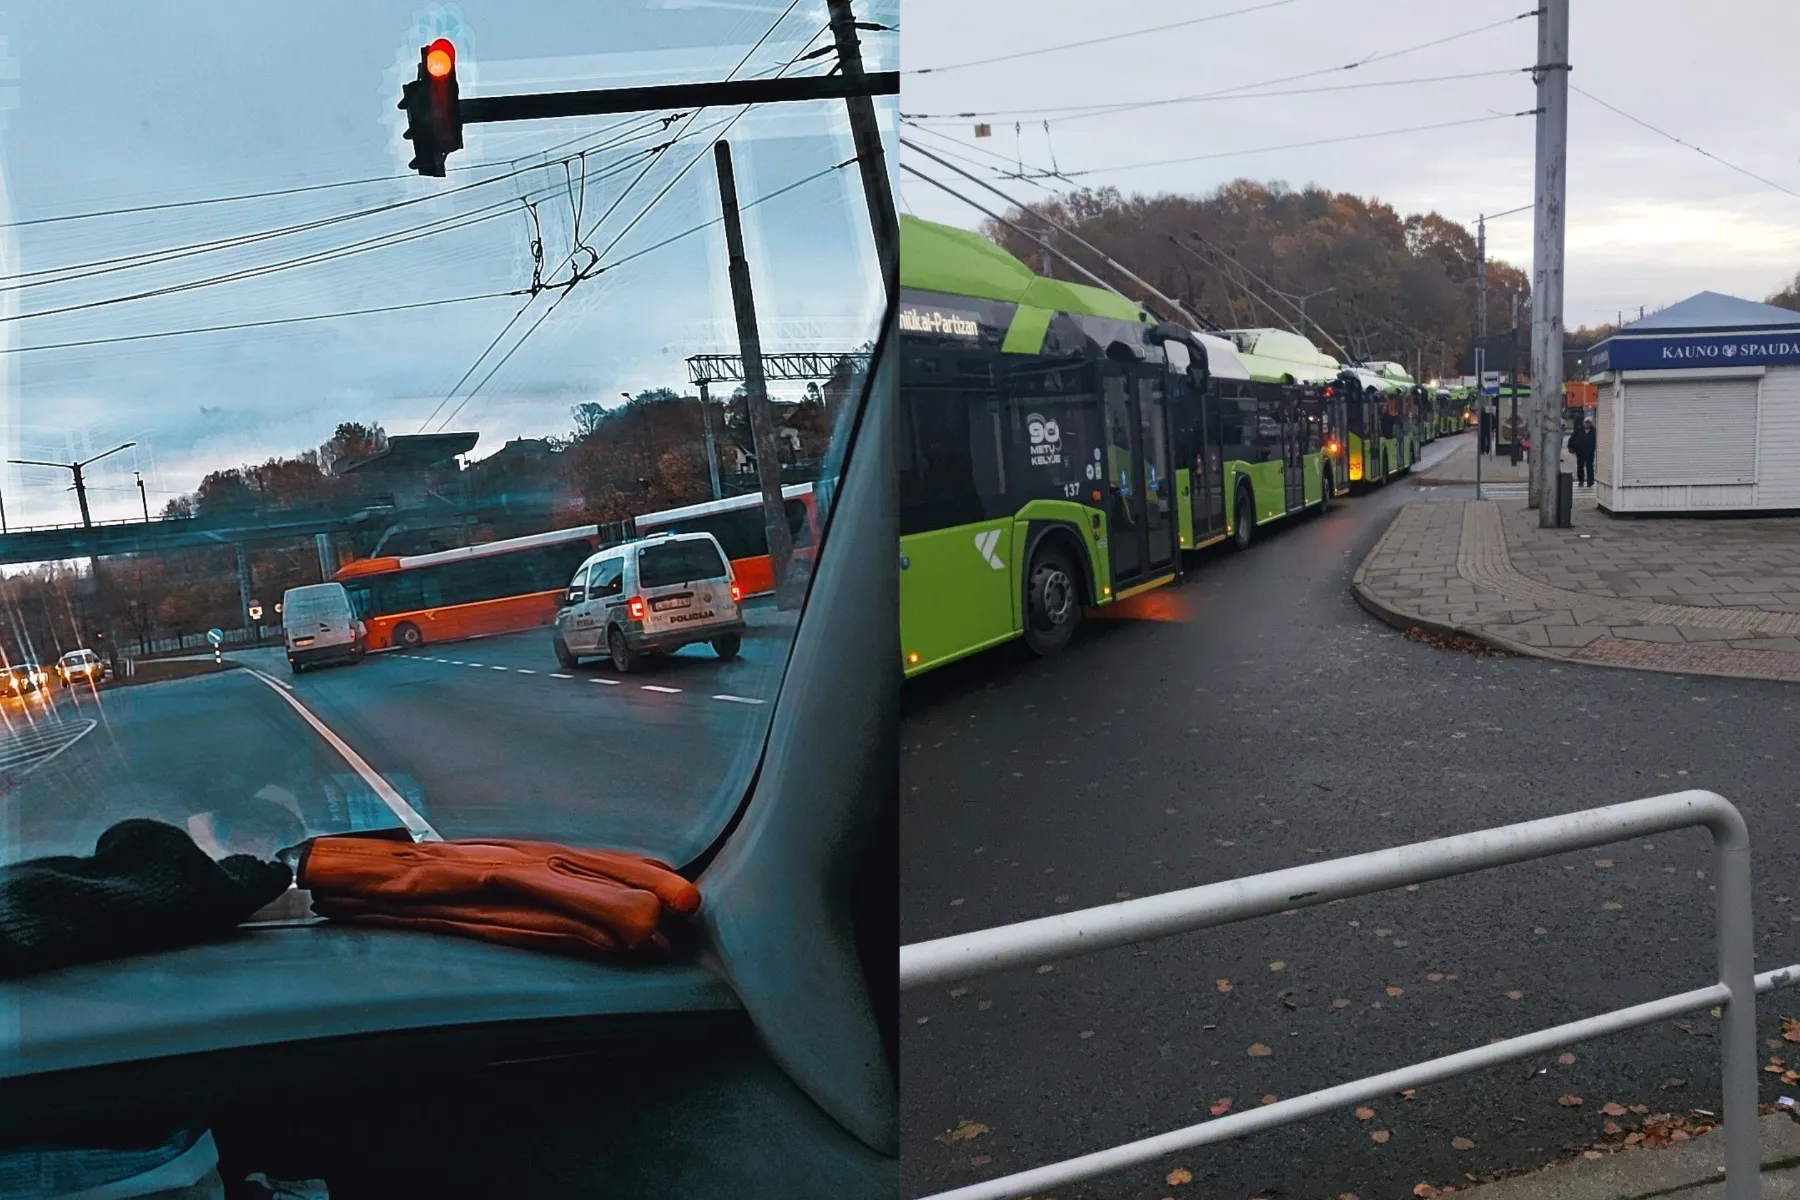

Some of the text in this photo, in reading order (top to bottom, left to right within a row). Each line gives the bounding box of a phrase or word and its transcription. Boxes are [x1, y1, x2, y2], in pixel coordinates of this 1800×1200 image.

[1662, 342, 1800, 359] KAUNO SPAUDA
[1029, 421, 1060, 444] 90
[1030, 444, 1055, 455] METŲ
[1031, 454, 1062, 466] KELYJE
[1064, 482, 1080, 497] 137
[669, 610, 715, 624] POLICIJA
